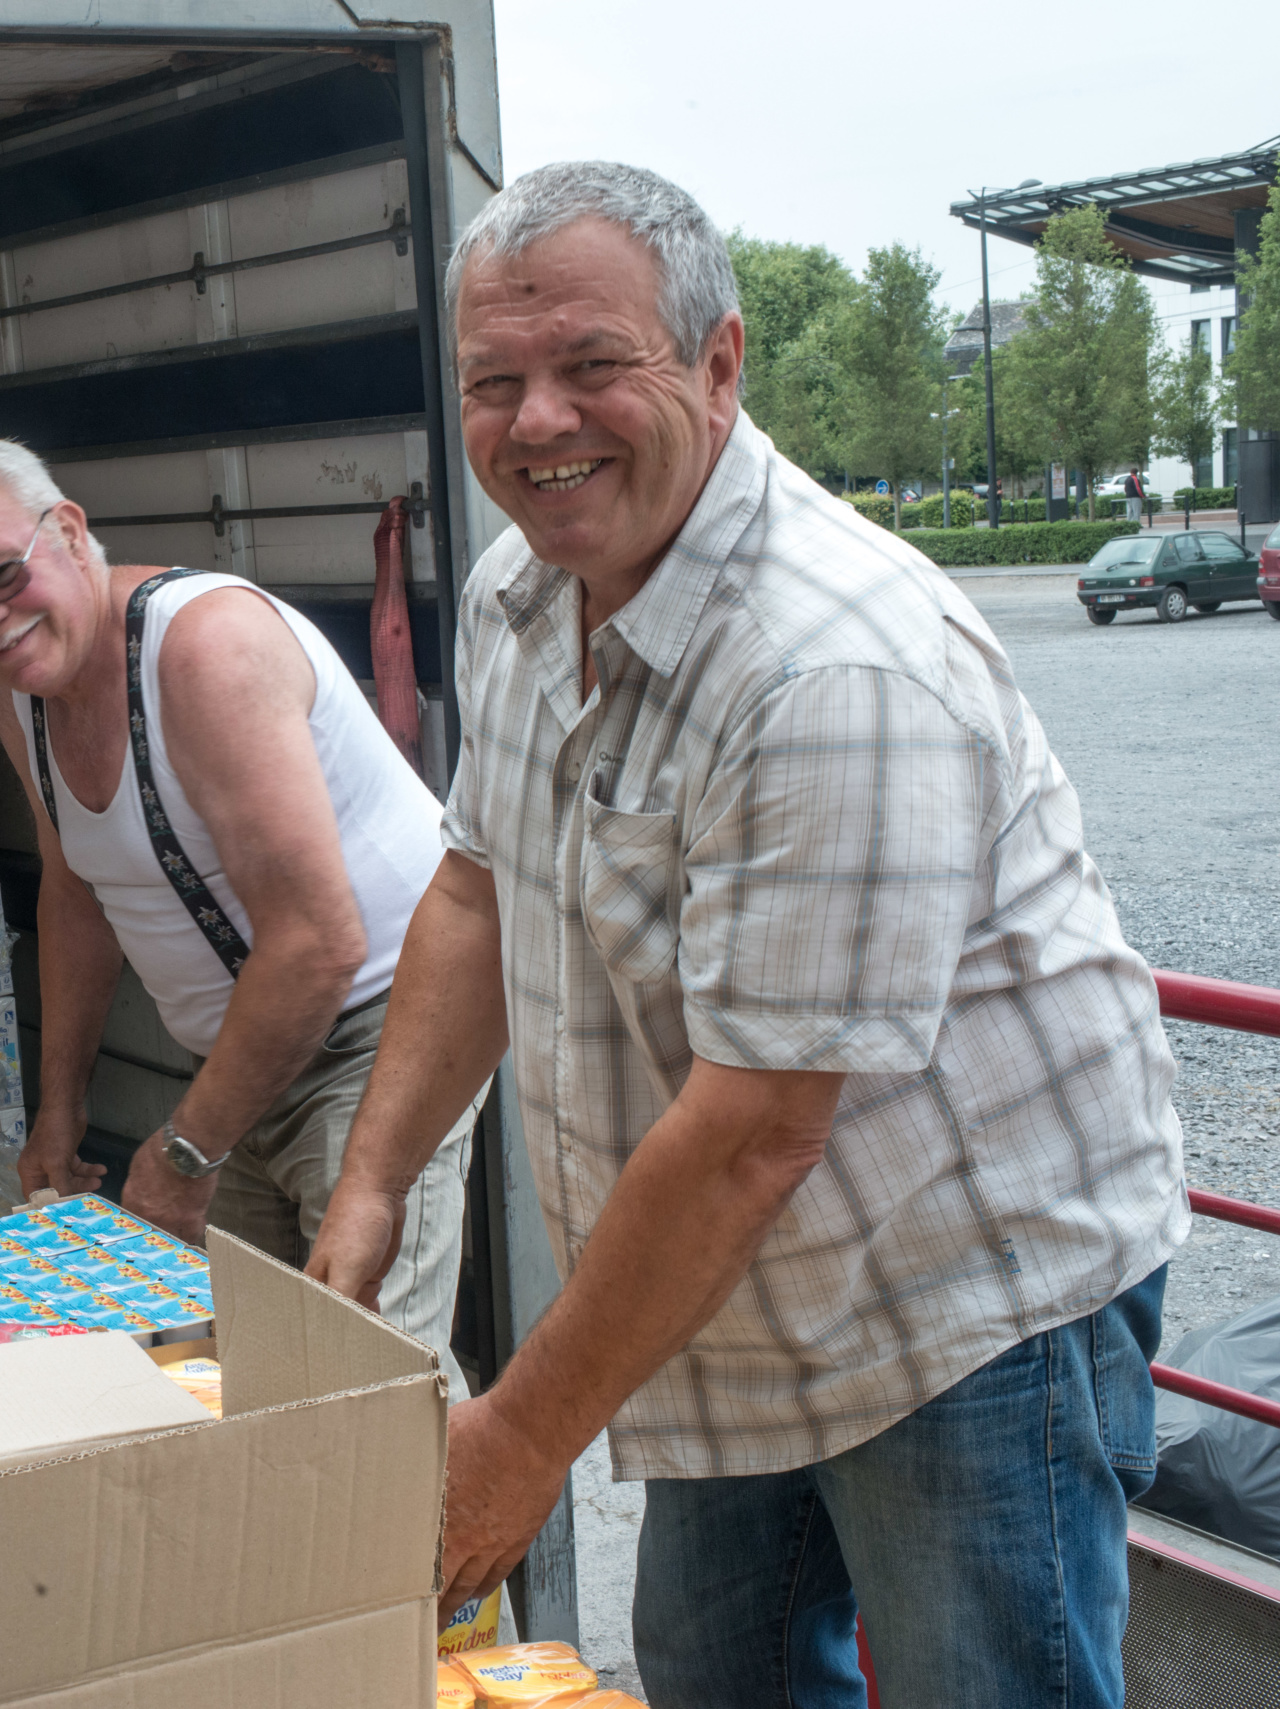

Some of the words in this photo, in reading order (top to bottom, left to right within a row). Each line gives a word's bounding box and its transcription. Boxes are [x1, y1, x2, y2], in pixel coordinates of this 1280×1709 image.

[437, 1626, 497, 1657] oudre
[441, 1631, 466, 1646] Sucre
[479, 1664, 531, 1677] Béghin
[493, 1671, 523, 1682] Say
